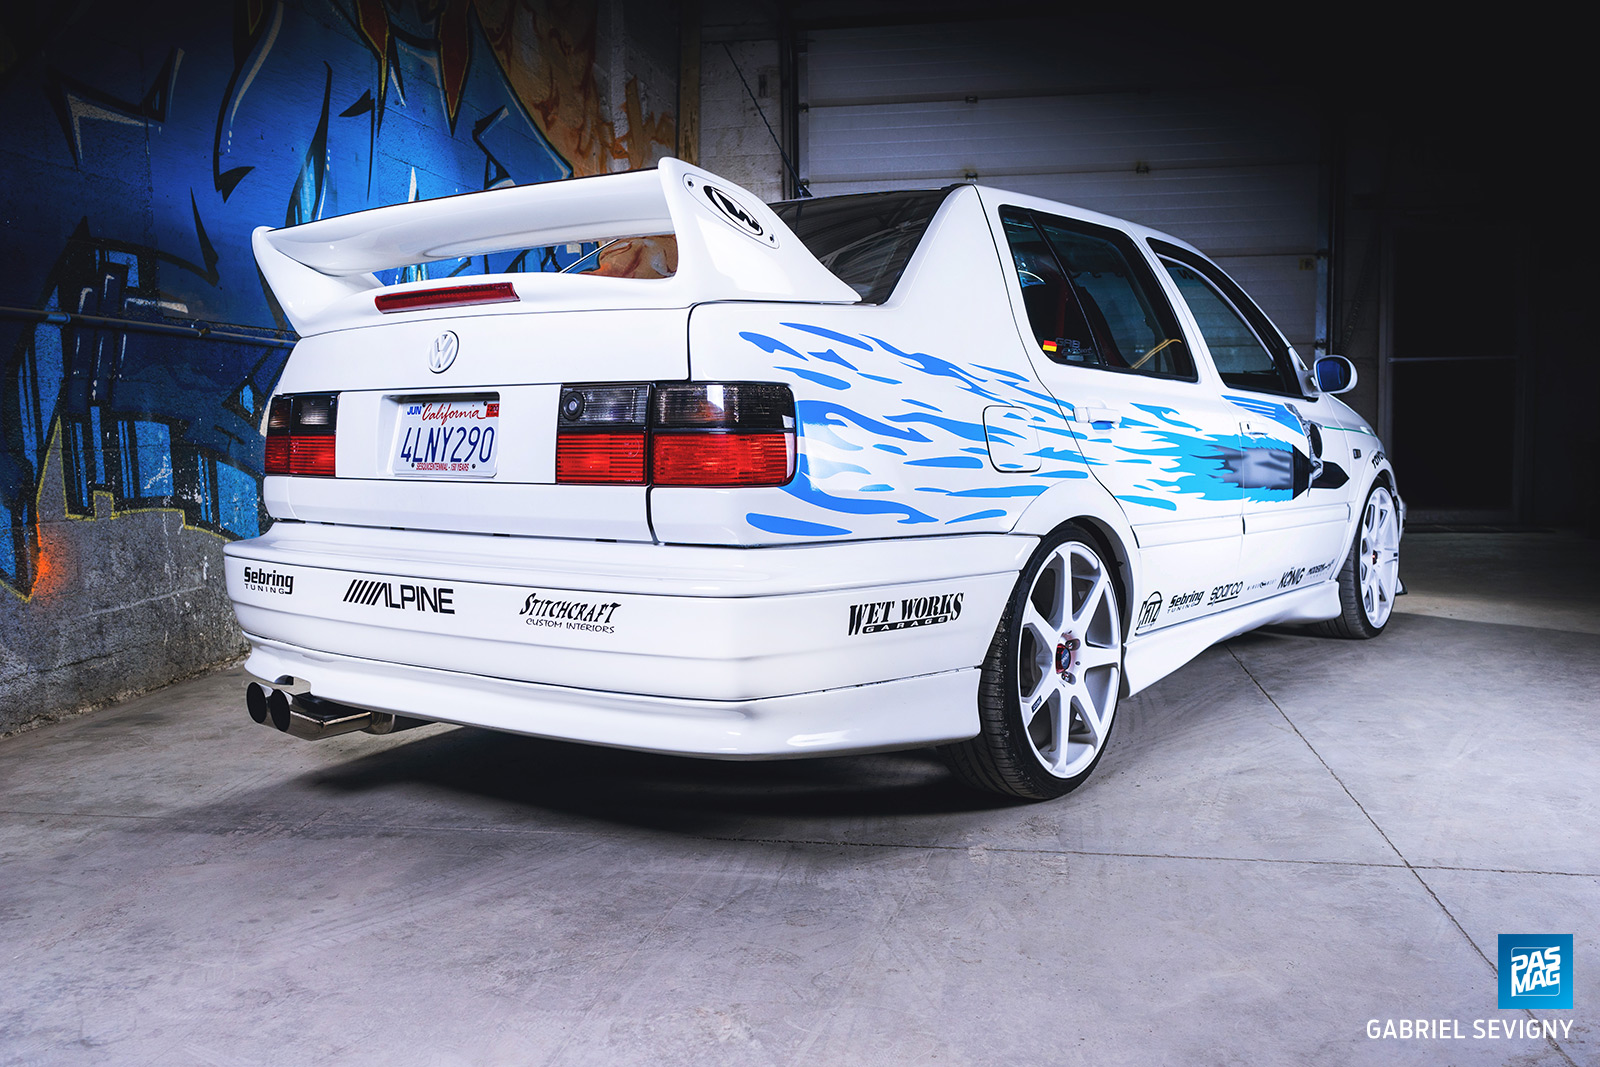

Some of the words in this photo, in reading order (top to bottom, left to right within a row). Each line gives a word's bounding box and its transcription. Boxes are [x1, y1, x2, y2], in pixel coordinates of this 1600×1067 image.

[406, 405, 422, 416] JUN
[422, 403, 487, 426] California
[400, 426, 495, 463] 4LNY290
[457, 463, 470, 471] YEARS
[244, 566, 294, 595] Sebring
[244, 583, 286, 595] TUNING
[1168, 590, 1206, 609] Sebring
[1209, 580, 1244, 602] sparco
[519, 592, 622, 624] STITCHCRAFT
[847, 600, 895, 636] WET
[901, 592, 964, 621] WORKS
[1166, 602, 1199, 614] TUNING
[525, 617, 563, 628] CUSTOM
[566, 621, 615, 634] INTERIORS
[865, 616, 946, 633] GARAGE
